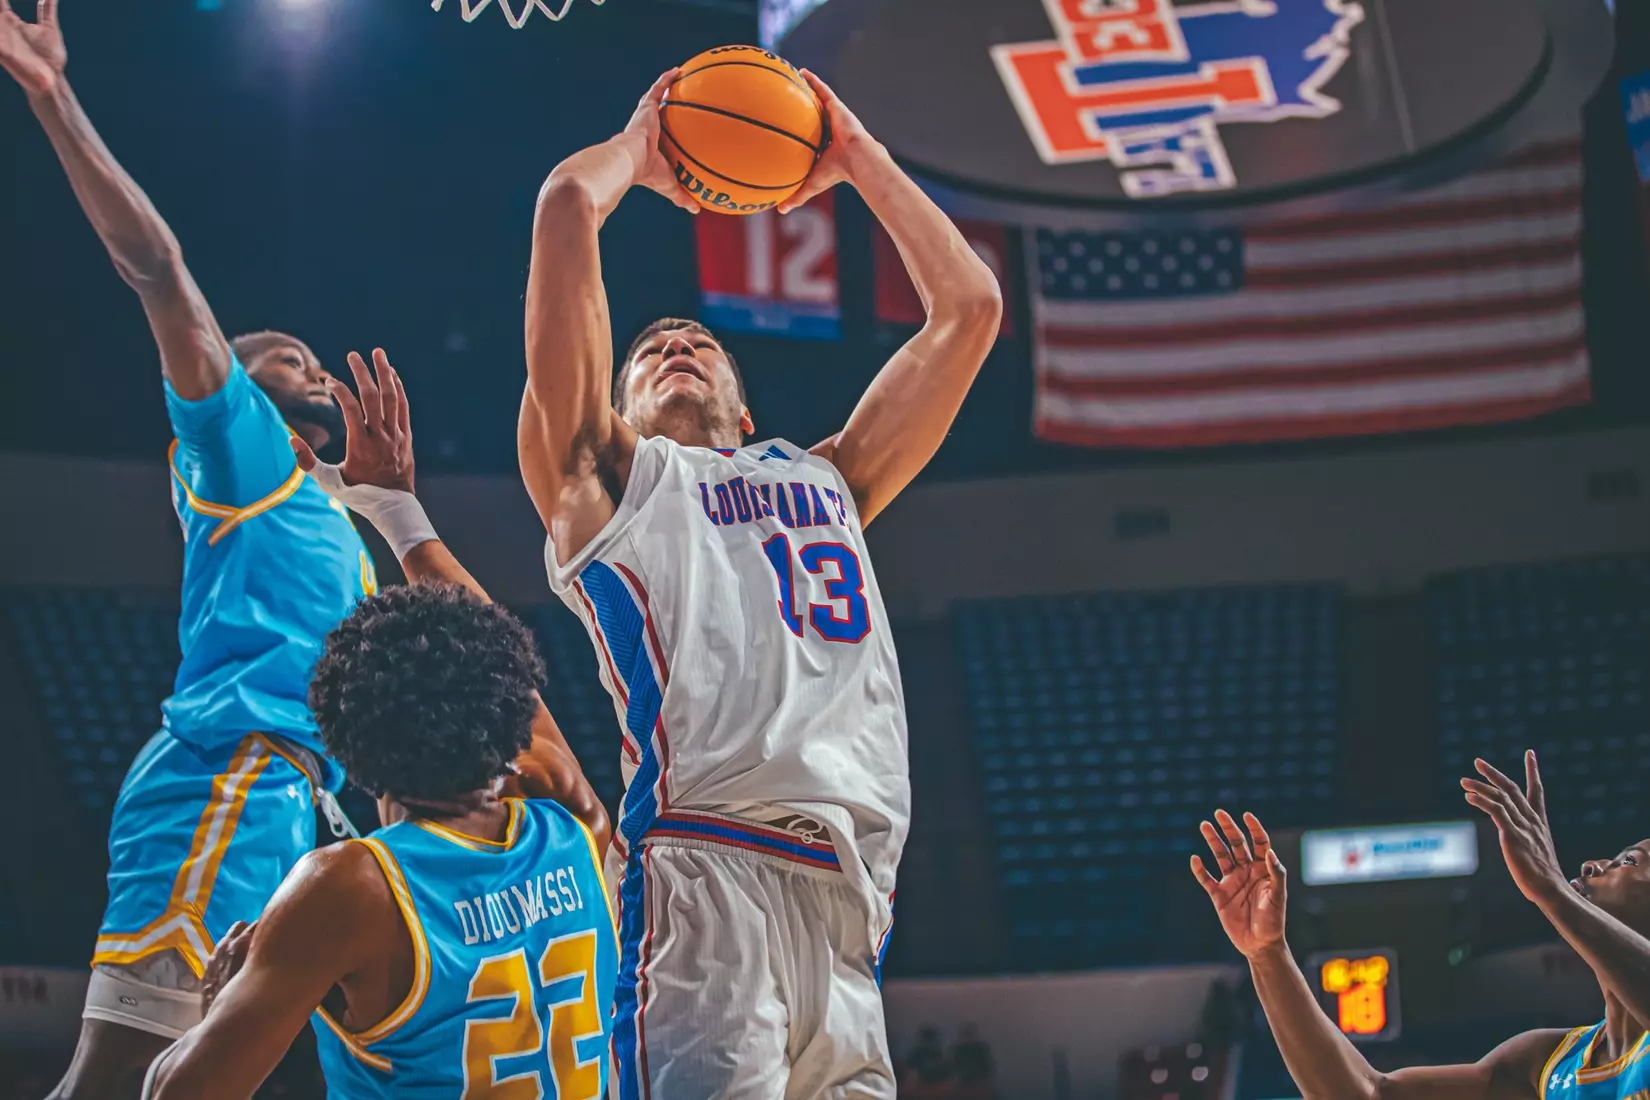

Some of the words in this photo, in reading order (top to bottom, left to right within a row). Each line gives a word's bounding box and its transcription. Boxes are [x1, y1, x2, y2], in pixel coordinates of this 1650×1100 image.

[674, 160, 776, 212] Wilson
[744, 205, 837, 303] 12
[761, 532, 872, 645] 13
[454, 865, 583, 945] DIOUMASSI
[459, 927, 604, 1100] 22
